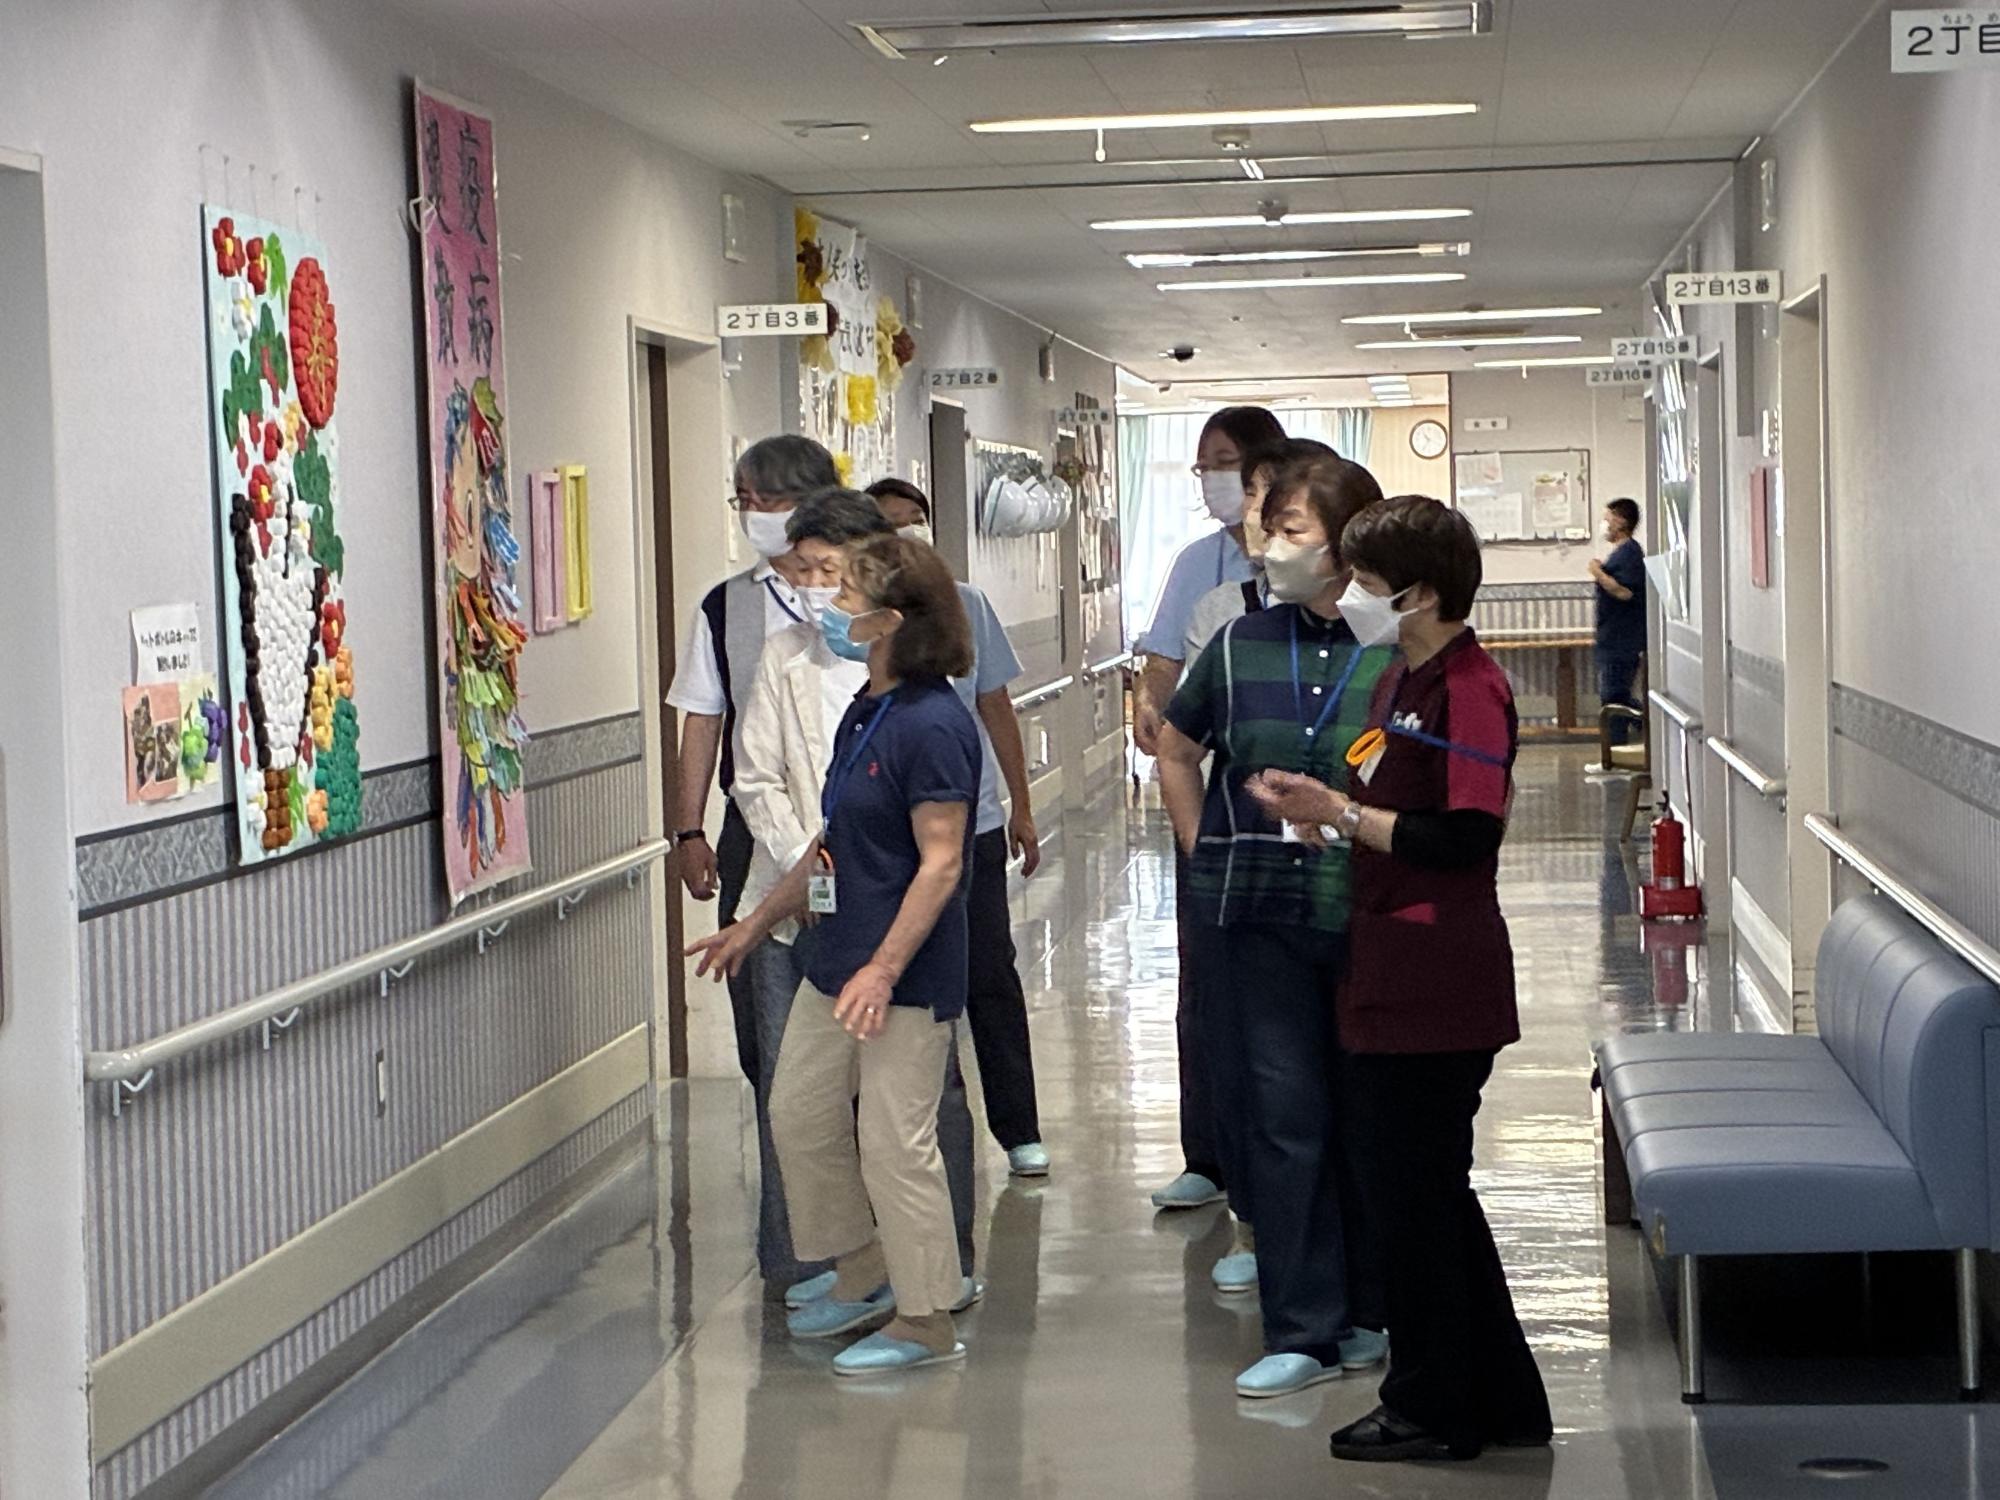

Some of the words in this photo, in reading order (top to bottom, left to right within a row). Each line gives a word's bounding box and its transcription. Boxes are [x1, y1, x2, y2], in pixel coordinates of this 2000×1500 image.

[1907, 24, 2000, 56] 2丁目
[1674, 277, 1770, 298] 2丁目13番
[726, 310, 819, 329] 2丁目3番
[1616, 340, 1690, 357] 2丁目15番
[931, 371, 998, 386] 2丁目2番
